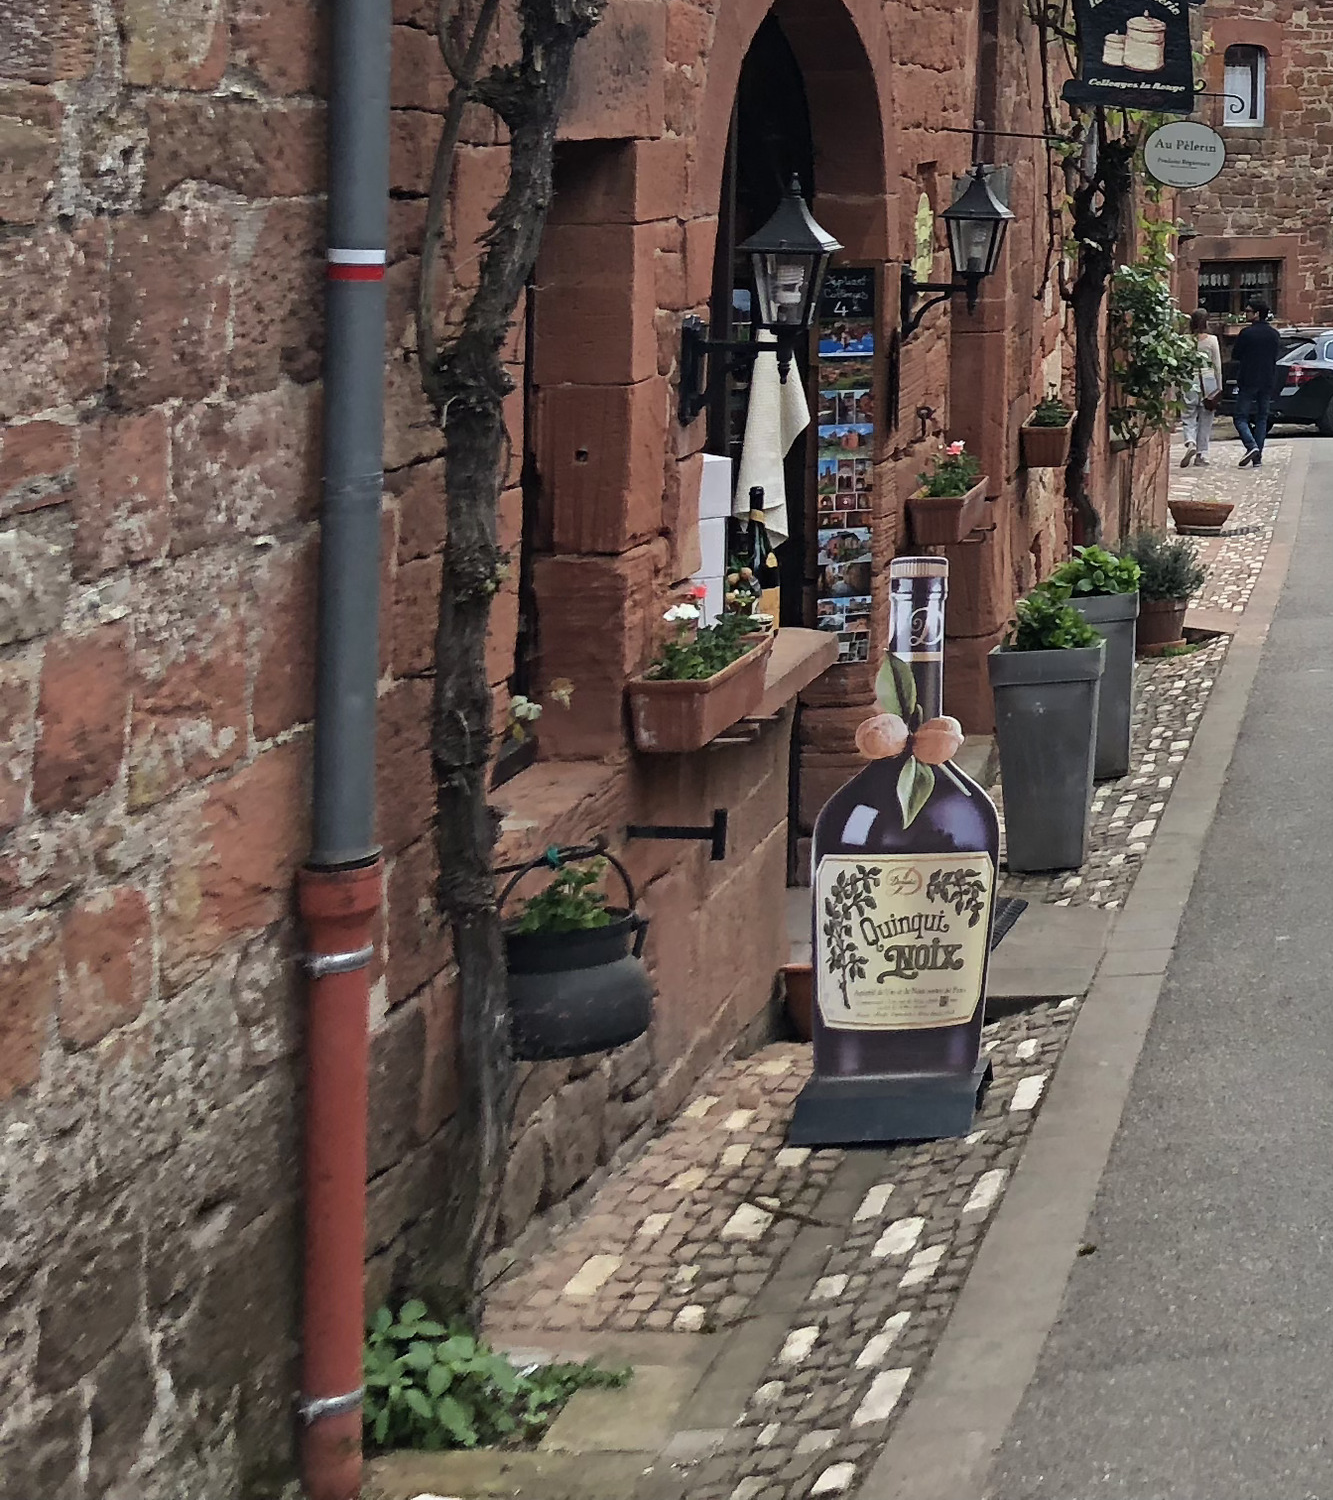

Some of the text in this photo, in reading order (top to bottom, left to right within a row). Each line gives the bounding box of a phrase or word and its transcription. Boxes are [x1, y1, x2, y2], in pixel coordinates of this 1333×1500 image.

[1088, 77, 1186, 93] Collonges la Rouge
[1154, 138, 1217, 153] Au Pèlerin
[859, 910, 950, 952] Quinqui
